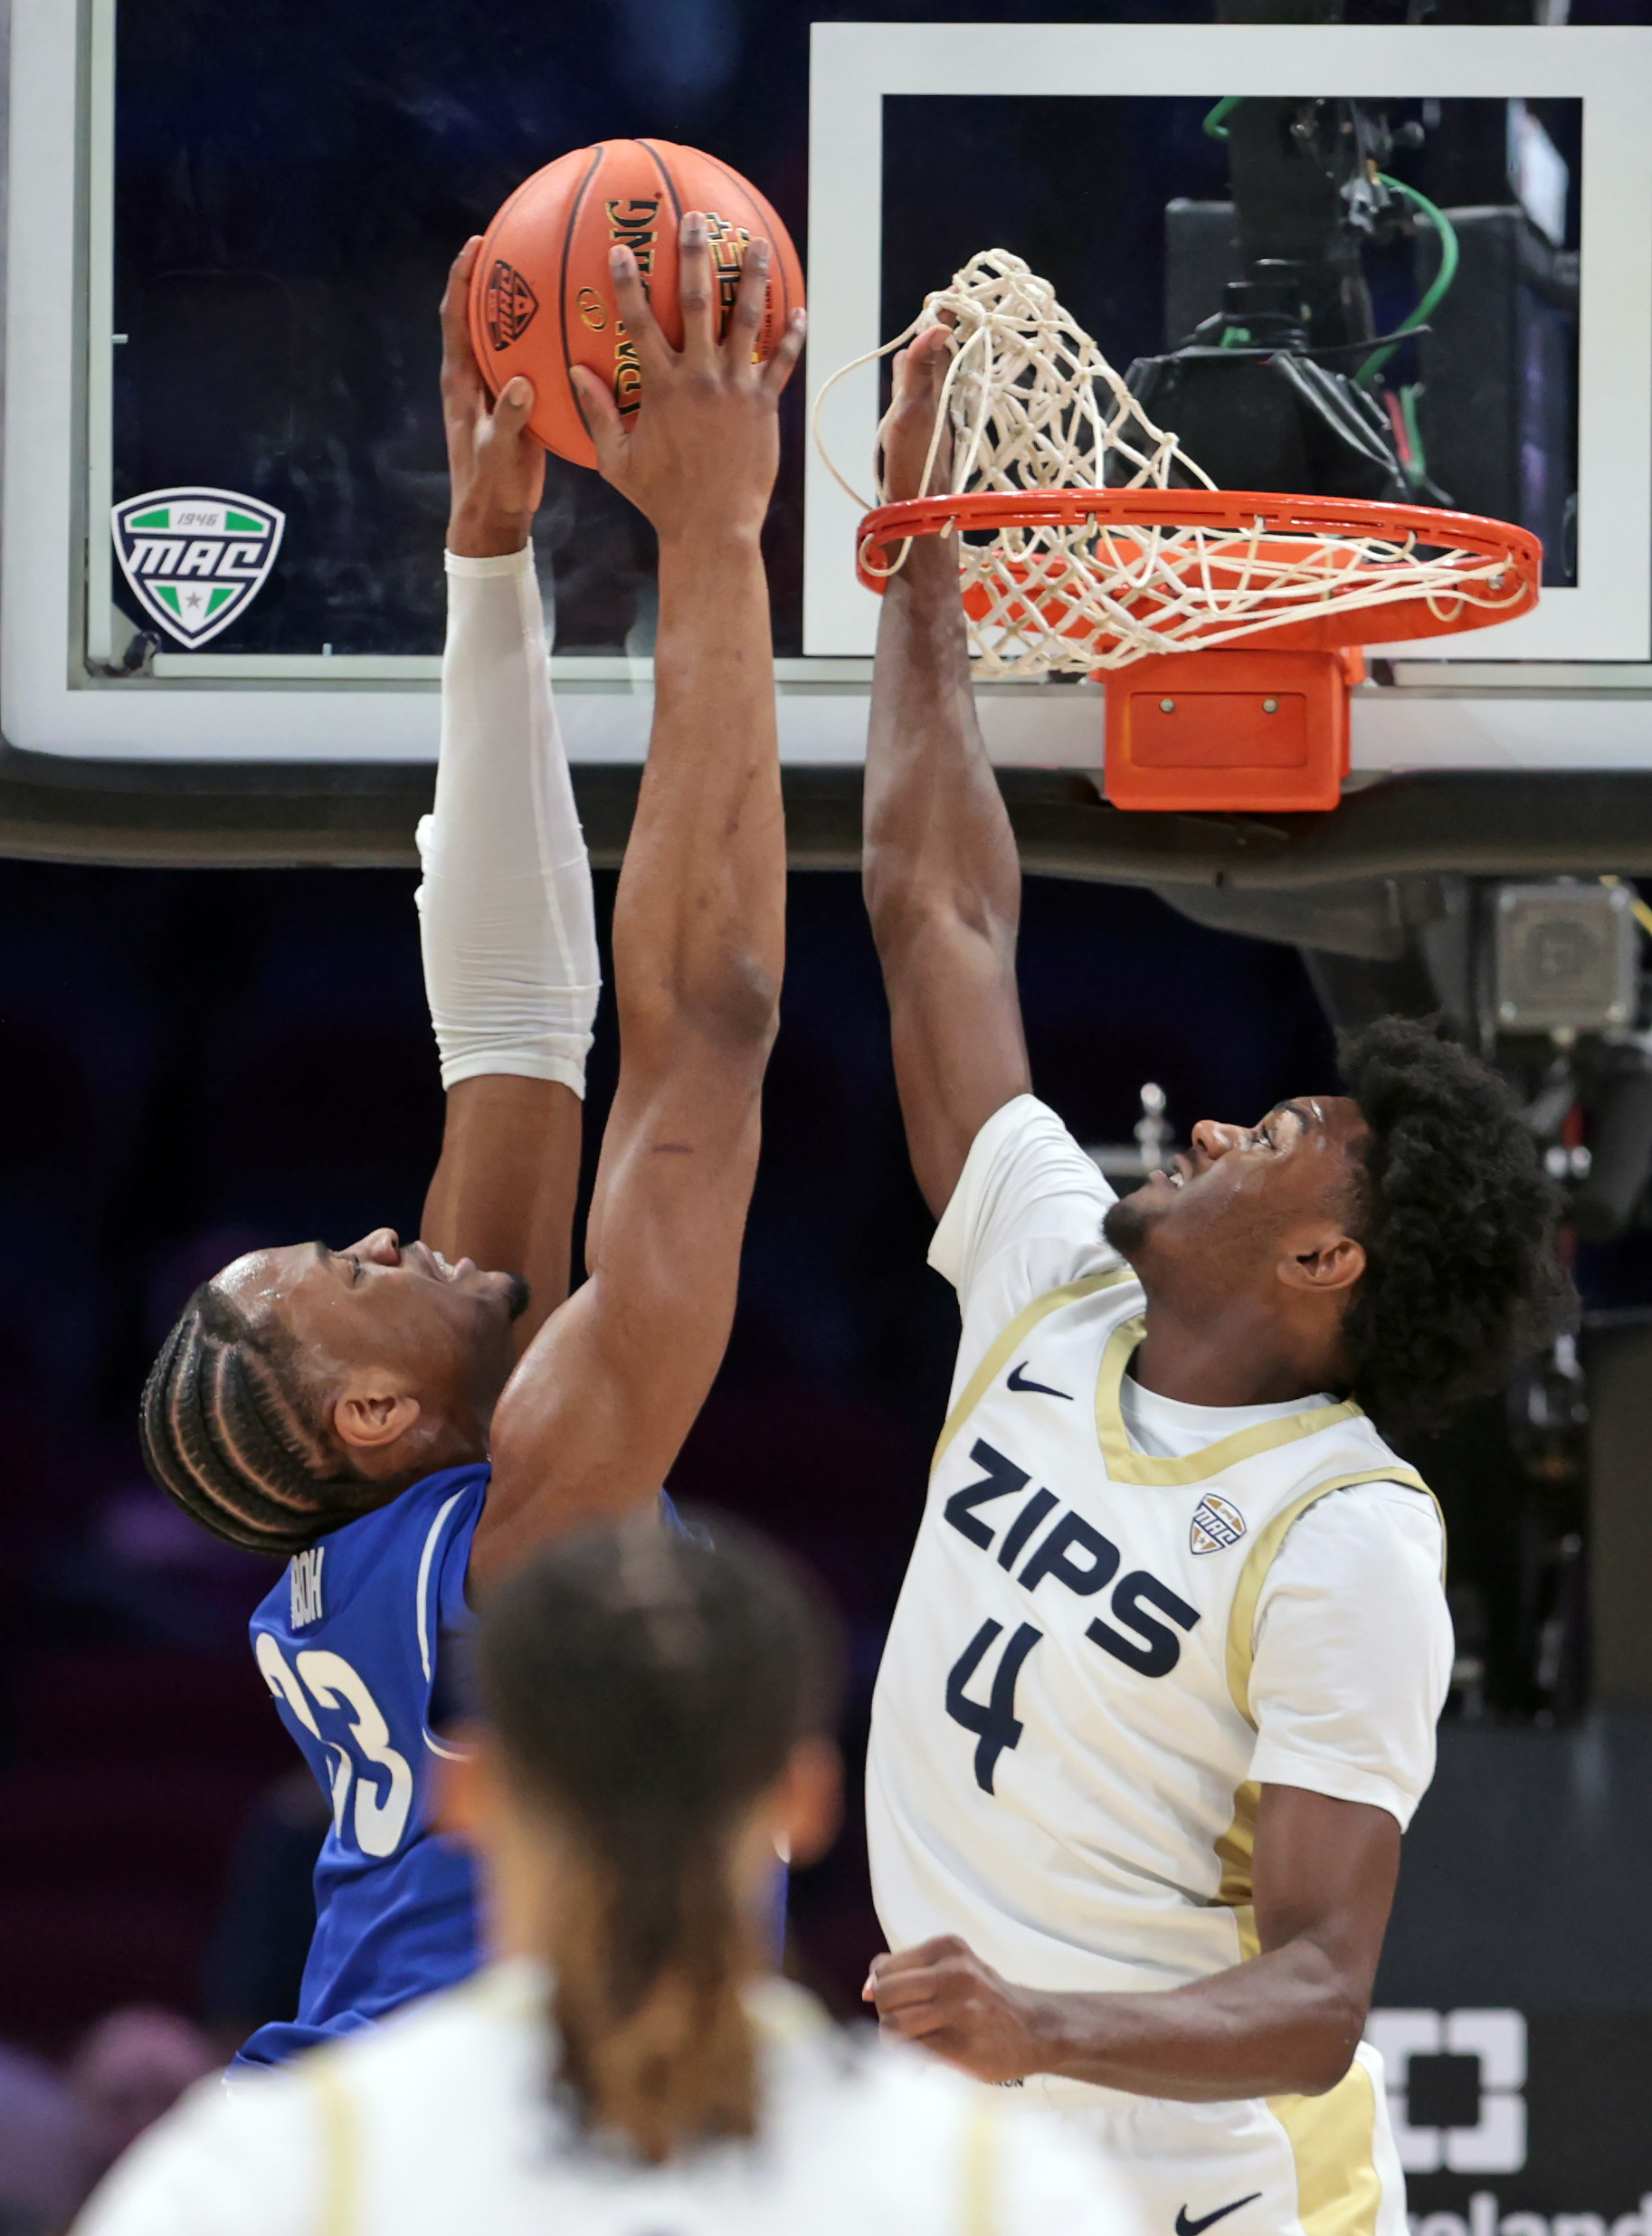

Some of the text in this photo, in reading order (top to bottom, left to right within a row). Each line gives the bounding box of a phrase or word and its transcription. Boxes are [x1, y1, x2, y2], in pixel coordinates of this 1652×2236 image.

[176, 511, 220, 527] 1946
[127, 538, 264, 578] MAC
[1193, 1505, 1239, 1546] MAC
[943, 1436, 1201, 1679] ZIPS
[945, 1616, 1045, 1797] 4
